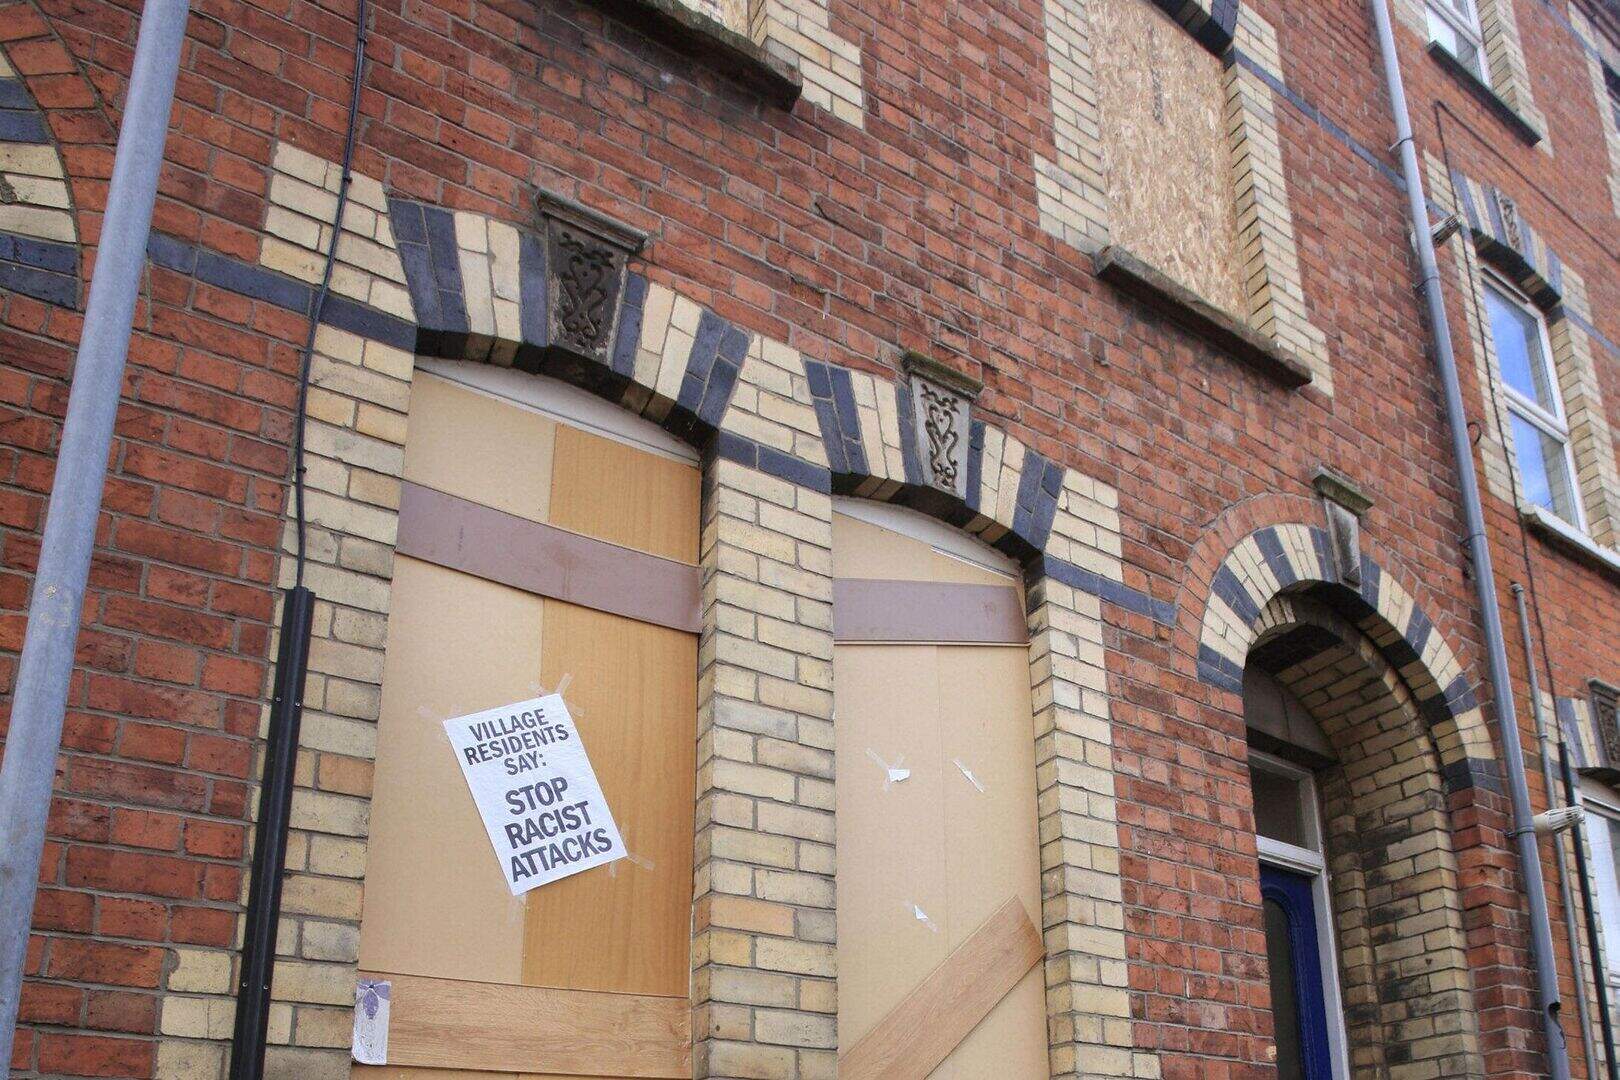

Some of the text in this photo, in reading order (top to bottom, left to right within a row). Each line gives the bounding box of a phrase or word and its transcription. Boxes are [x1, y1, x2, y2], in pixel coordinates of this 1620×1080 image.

[463, 724, 569, 765] RESIDENTS
[469, 708, 549, 742] VILLAGE
[504, 753, 547, 776] SAY:
[505, 776, 568, 815] STOP
[504, 801, 592, 850] RACIST
[511, 828, 613, 883] ATTACKS
